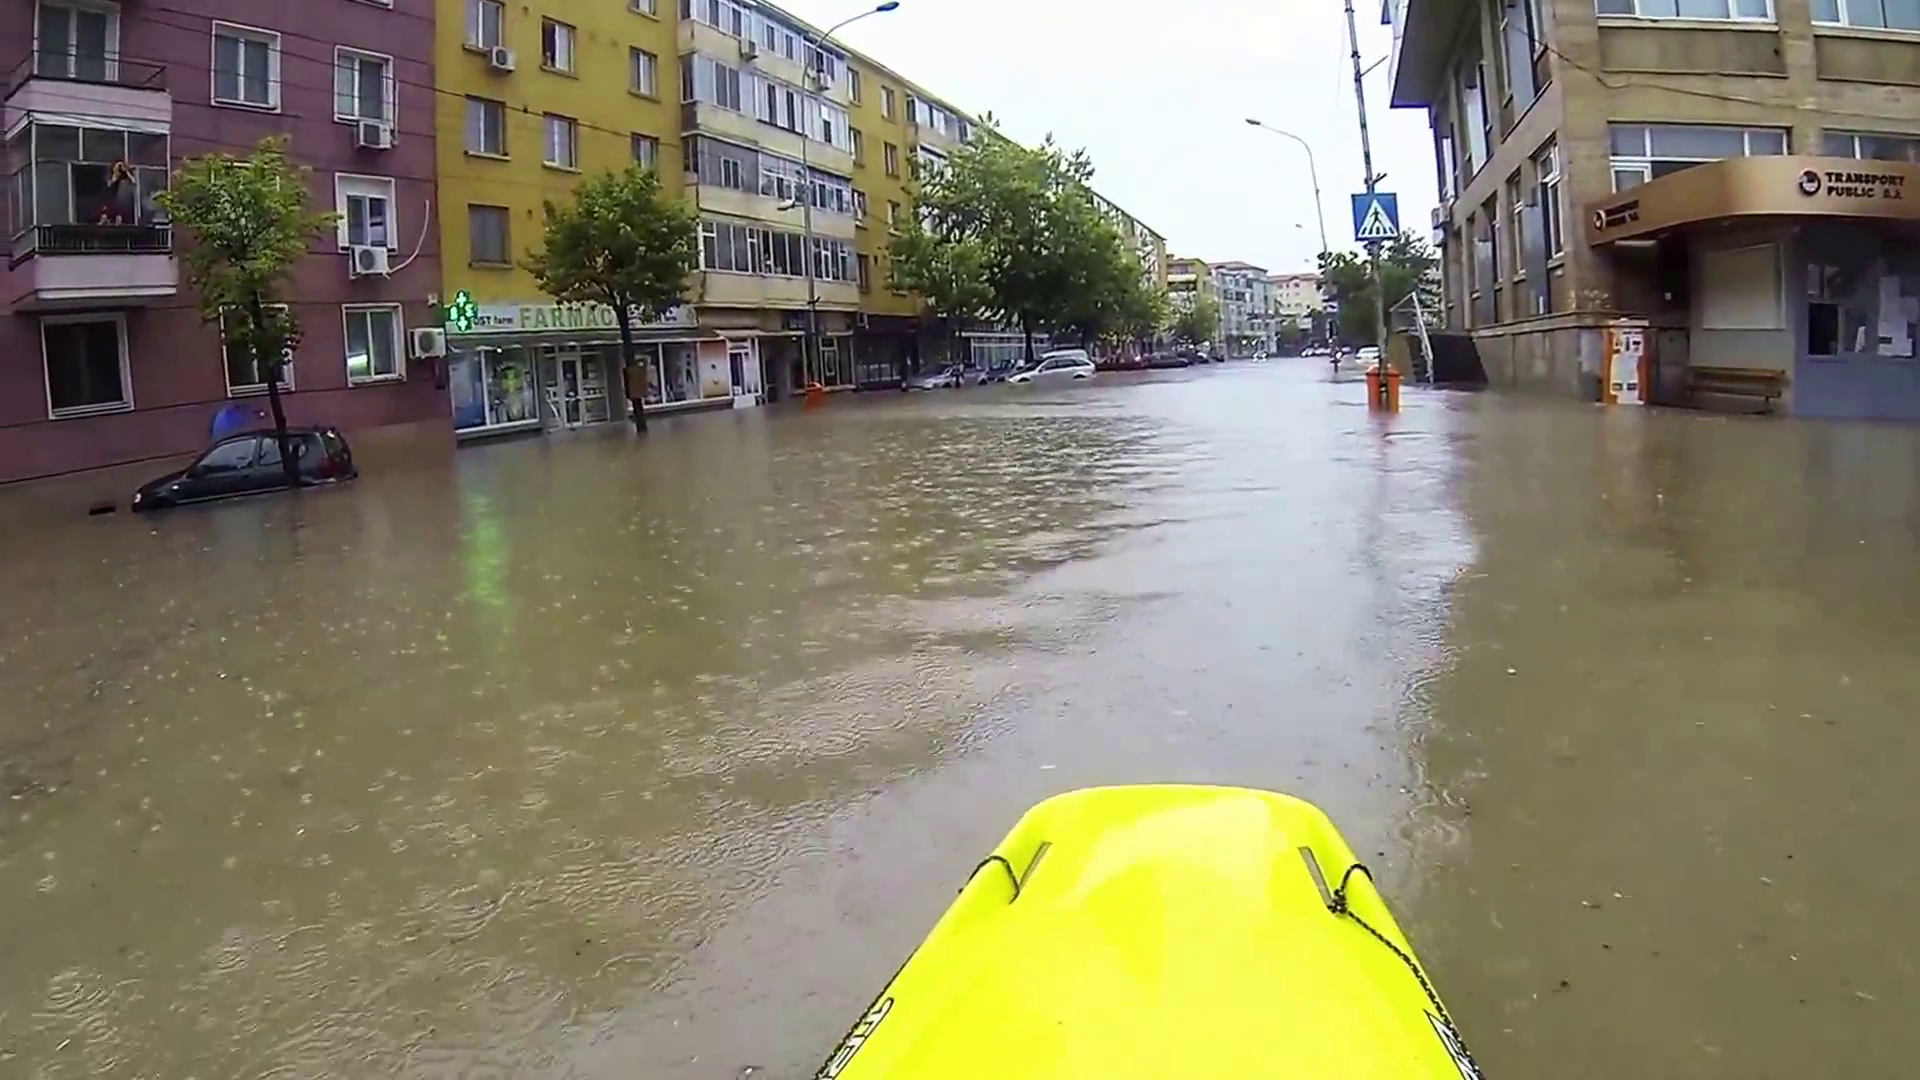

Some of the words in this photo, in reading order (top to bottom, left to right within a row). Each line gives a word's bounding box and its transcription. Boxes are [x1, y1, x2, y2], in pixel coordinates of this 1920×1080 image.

[1824, 172, 1905, 186] TRANSPORT
[1827, 186, 1875, 198] PUBLIC
[519, 307, 614, 328] FARMAC
